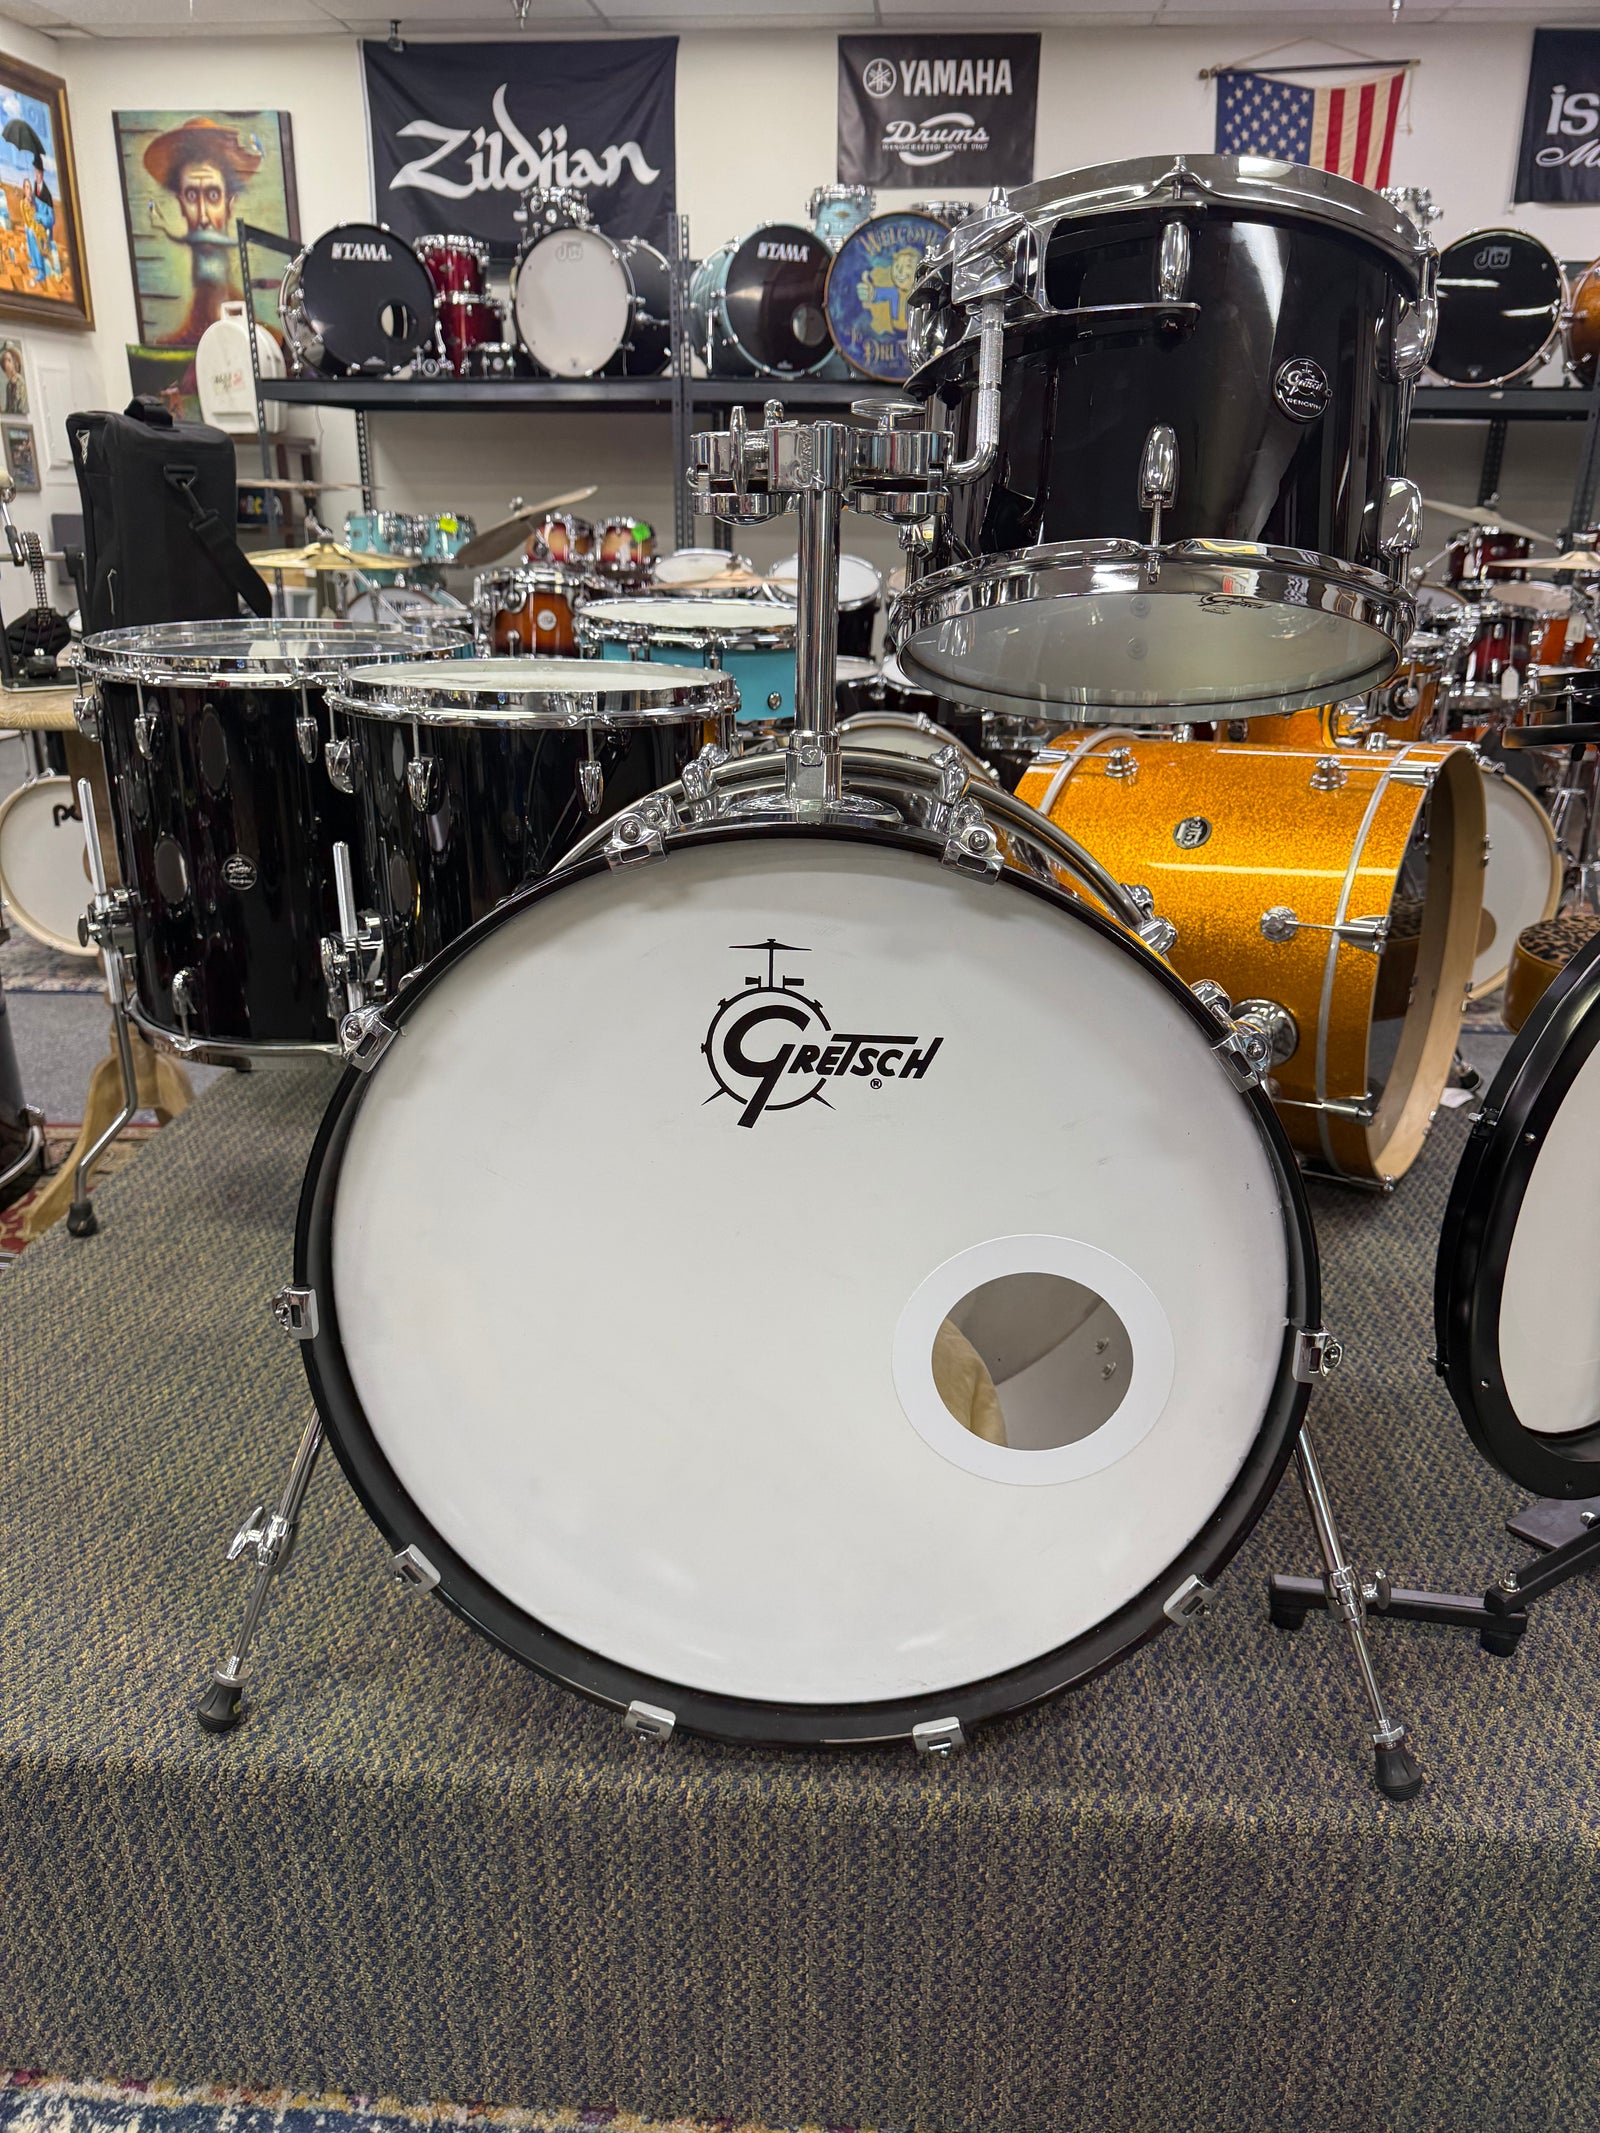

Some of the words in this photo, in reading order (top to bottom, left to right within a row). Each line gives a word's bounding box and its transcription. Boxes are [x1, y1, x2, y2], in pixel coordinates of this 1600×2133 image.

[900, 59, 1013, 97] YAMAHA
[389, 82, 661, 200] Zildjian
[881, 120, 990, 144] Drums
[342, 242, 388, 261] TAMA
